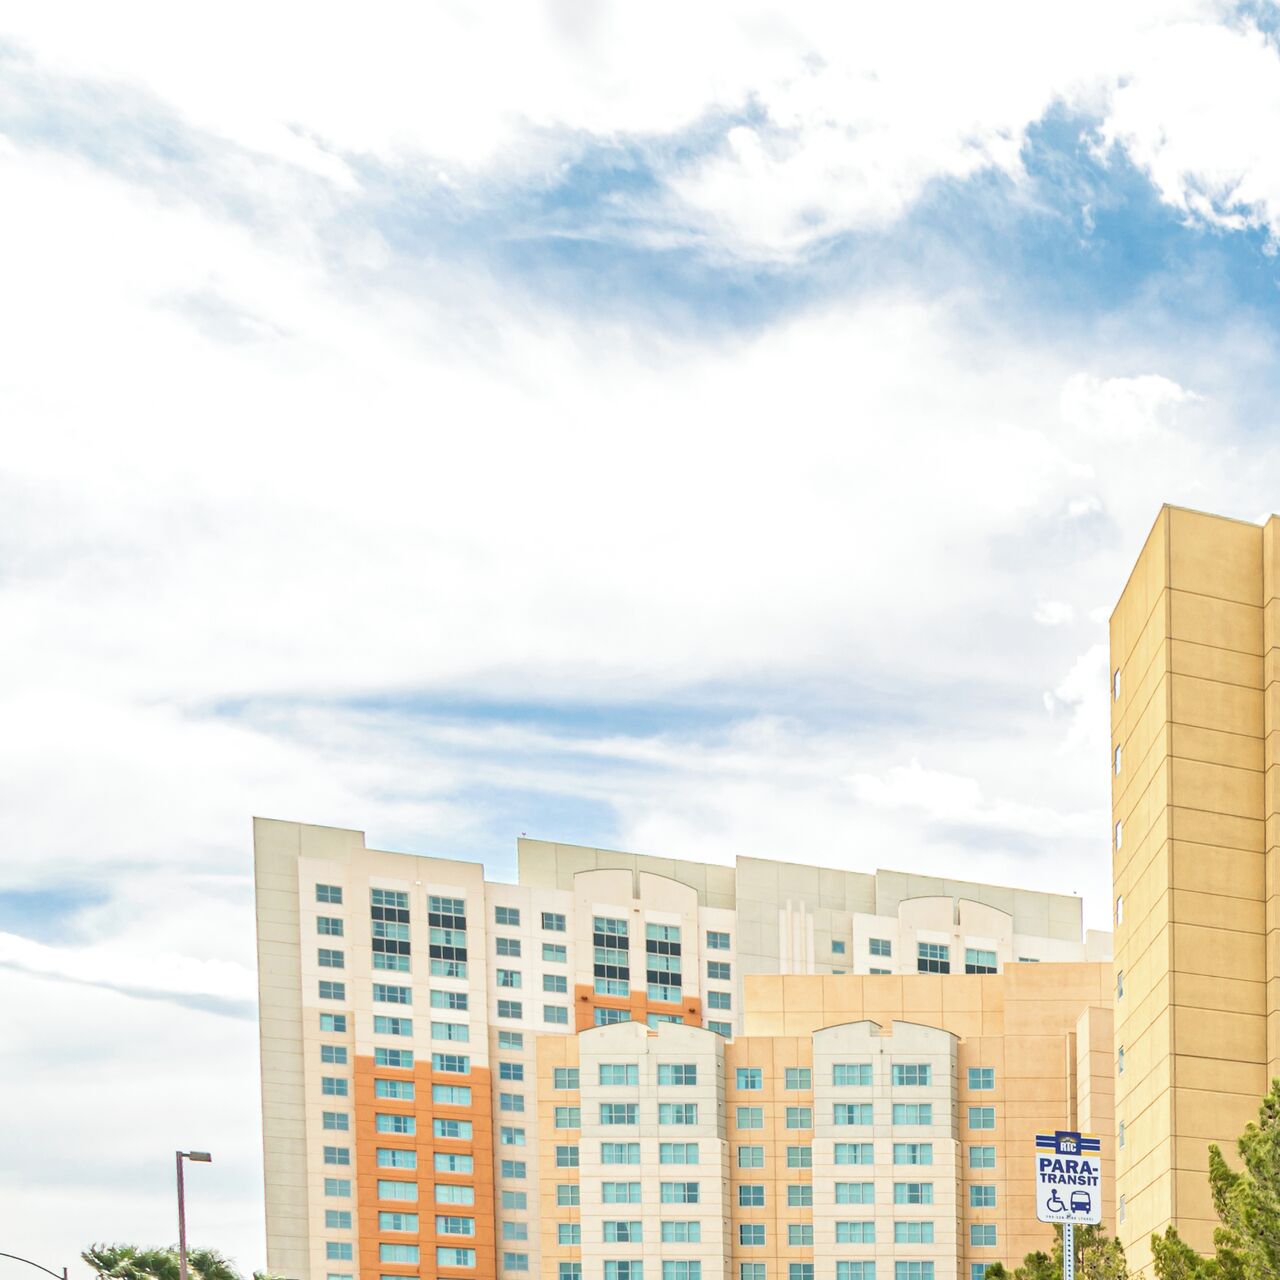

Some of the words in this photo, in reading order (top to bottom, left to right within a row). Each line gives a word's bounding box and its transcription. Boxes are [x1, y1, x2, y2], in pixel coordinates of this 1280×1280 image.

[1060, 1142, 1077, 1152] RTC
[1039, 1158, 1098, 1175] PARA-
[1039, 1173, 1098, 1186] TRANSIT
